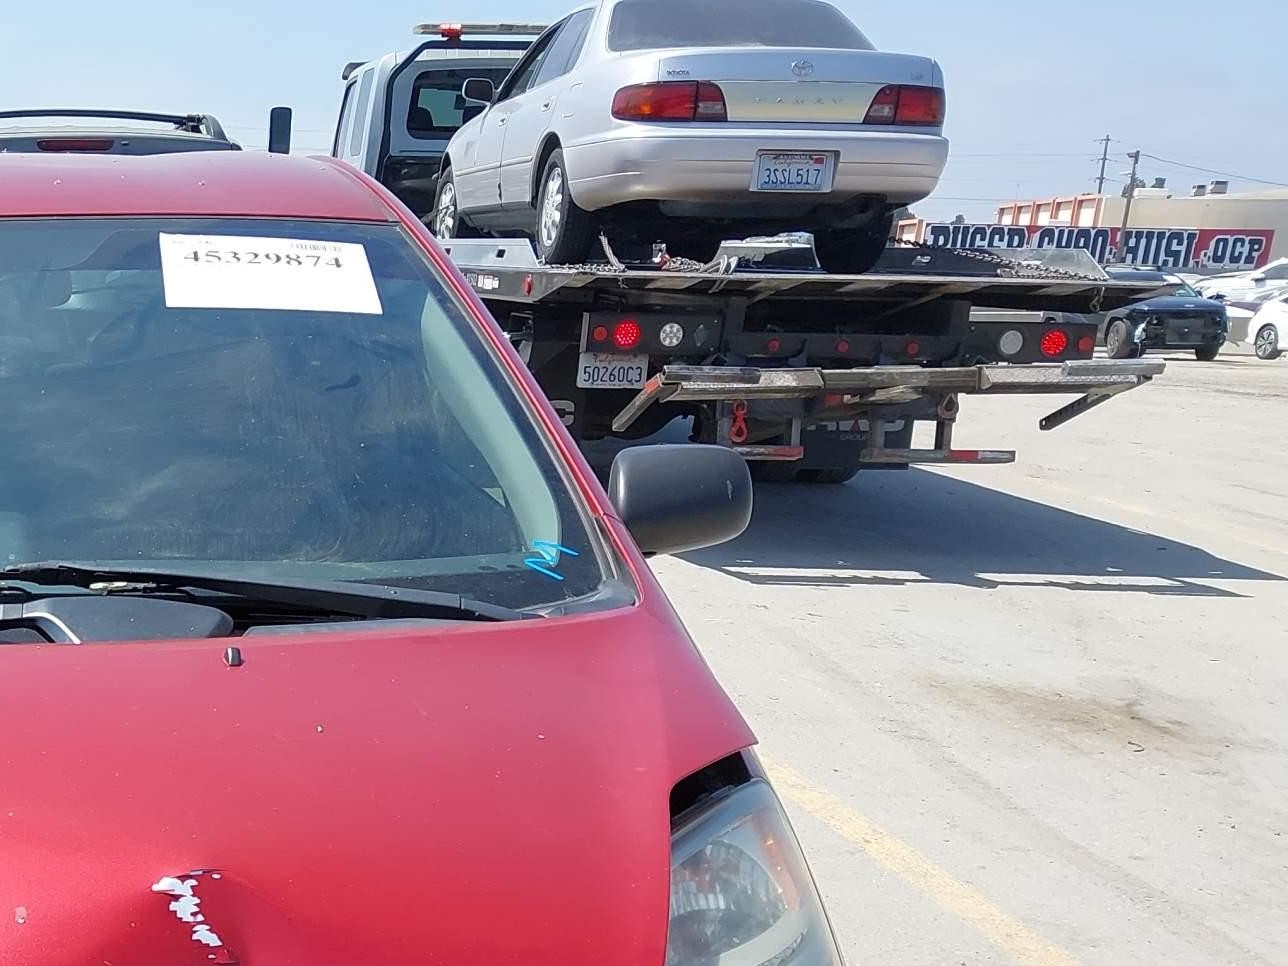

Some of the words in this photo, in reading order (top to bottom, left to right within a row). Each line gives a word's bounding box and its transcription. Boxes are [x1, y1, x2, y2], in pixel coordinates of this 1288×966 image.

[763, 167, 821, 185] 3SSL517
[183, 250, 343, 269] 45329874
[583, 365, 643, 383] 50260C3
